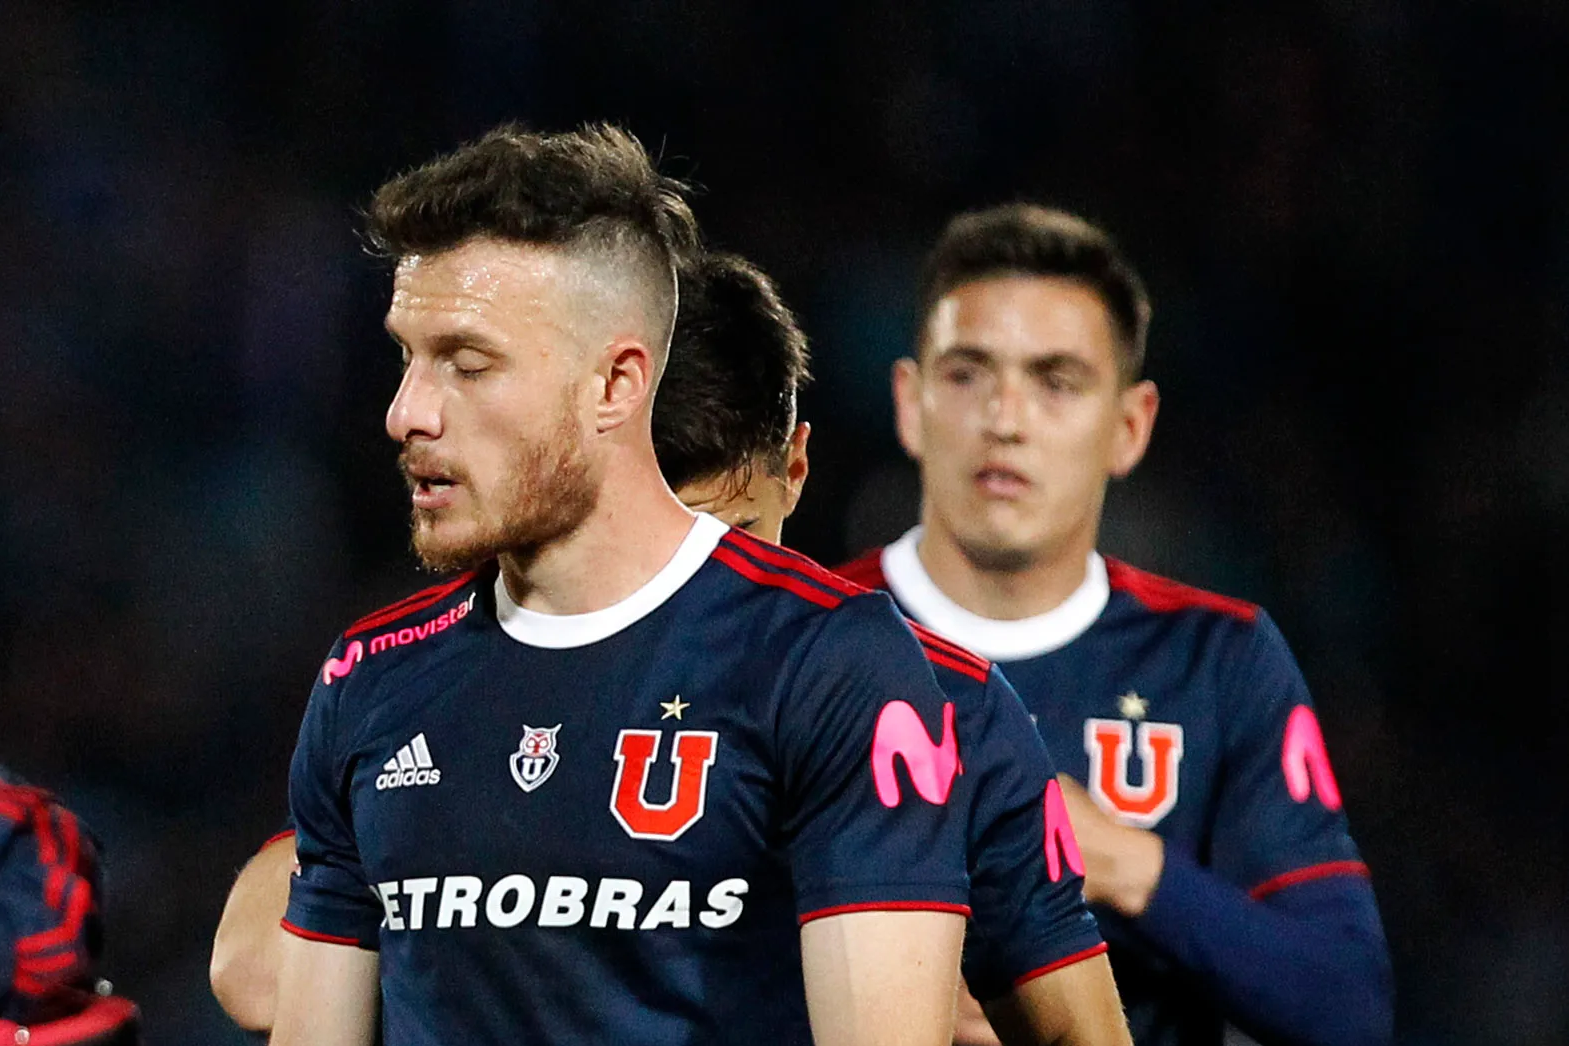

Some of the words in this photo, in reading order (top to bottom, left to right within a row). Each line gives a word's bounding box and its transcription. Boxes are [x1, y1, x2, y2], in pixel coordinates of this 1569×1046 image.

[369, 592, 476, 654] movistar
[375, 766, 441, 791] adidas
[609, 729, 719, 842] U
[1084, 717, 1185, 829] U
[369, 874, 750, 931] ETROBRAS
